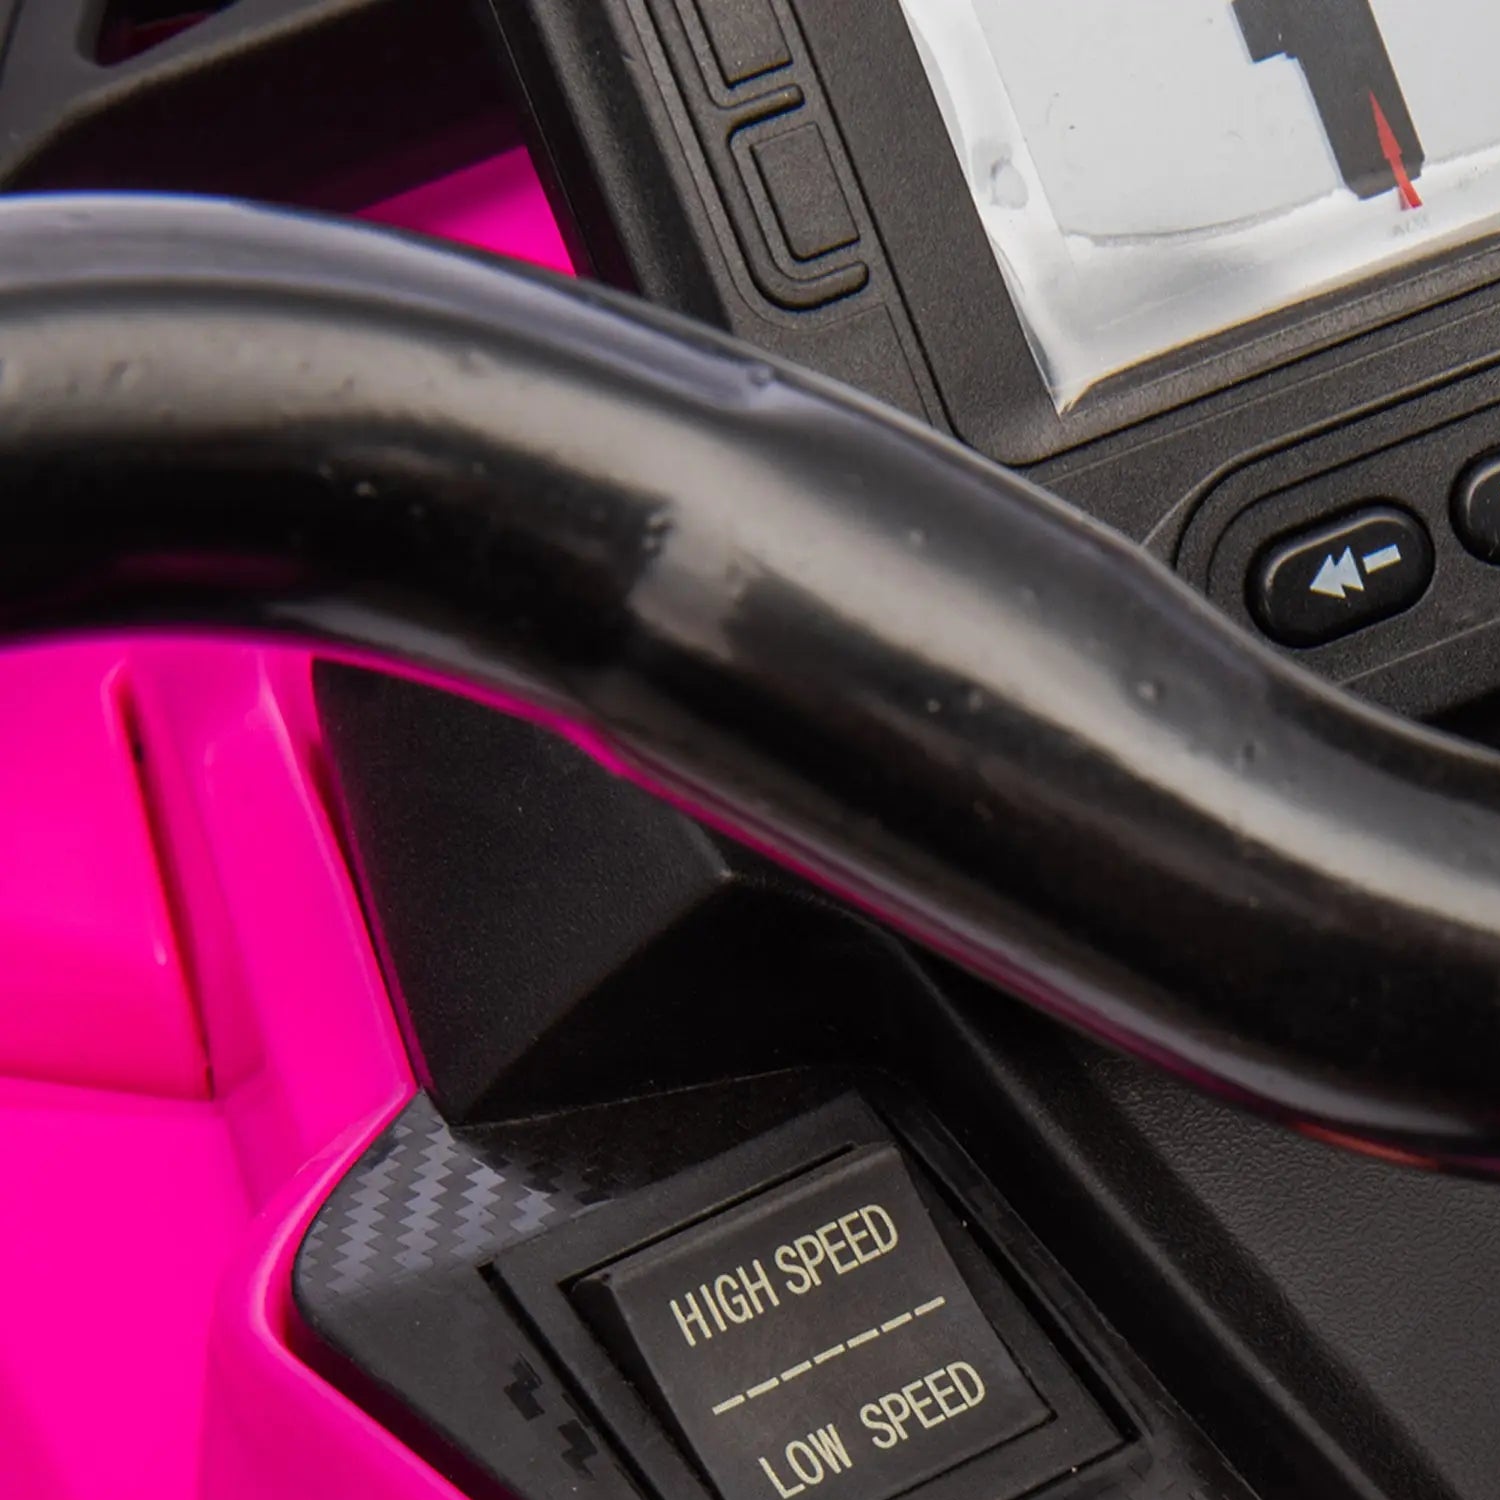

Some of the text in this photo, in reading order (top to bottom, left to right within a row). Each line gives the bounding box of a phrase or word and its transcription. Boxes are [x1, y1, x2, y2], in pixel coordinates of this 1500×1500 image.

[670, 1205, 898, 1346] HIGH SPEED
[758, 1362, 985, 1499] LOW SPEED
